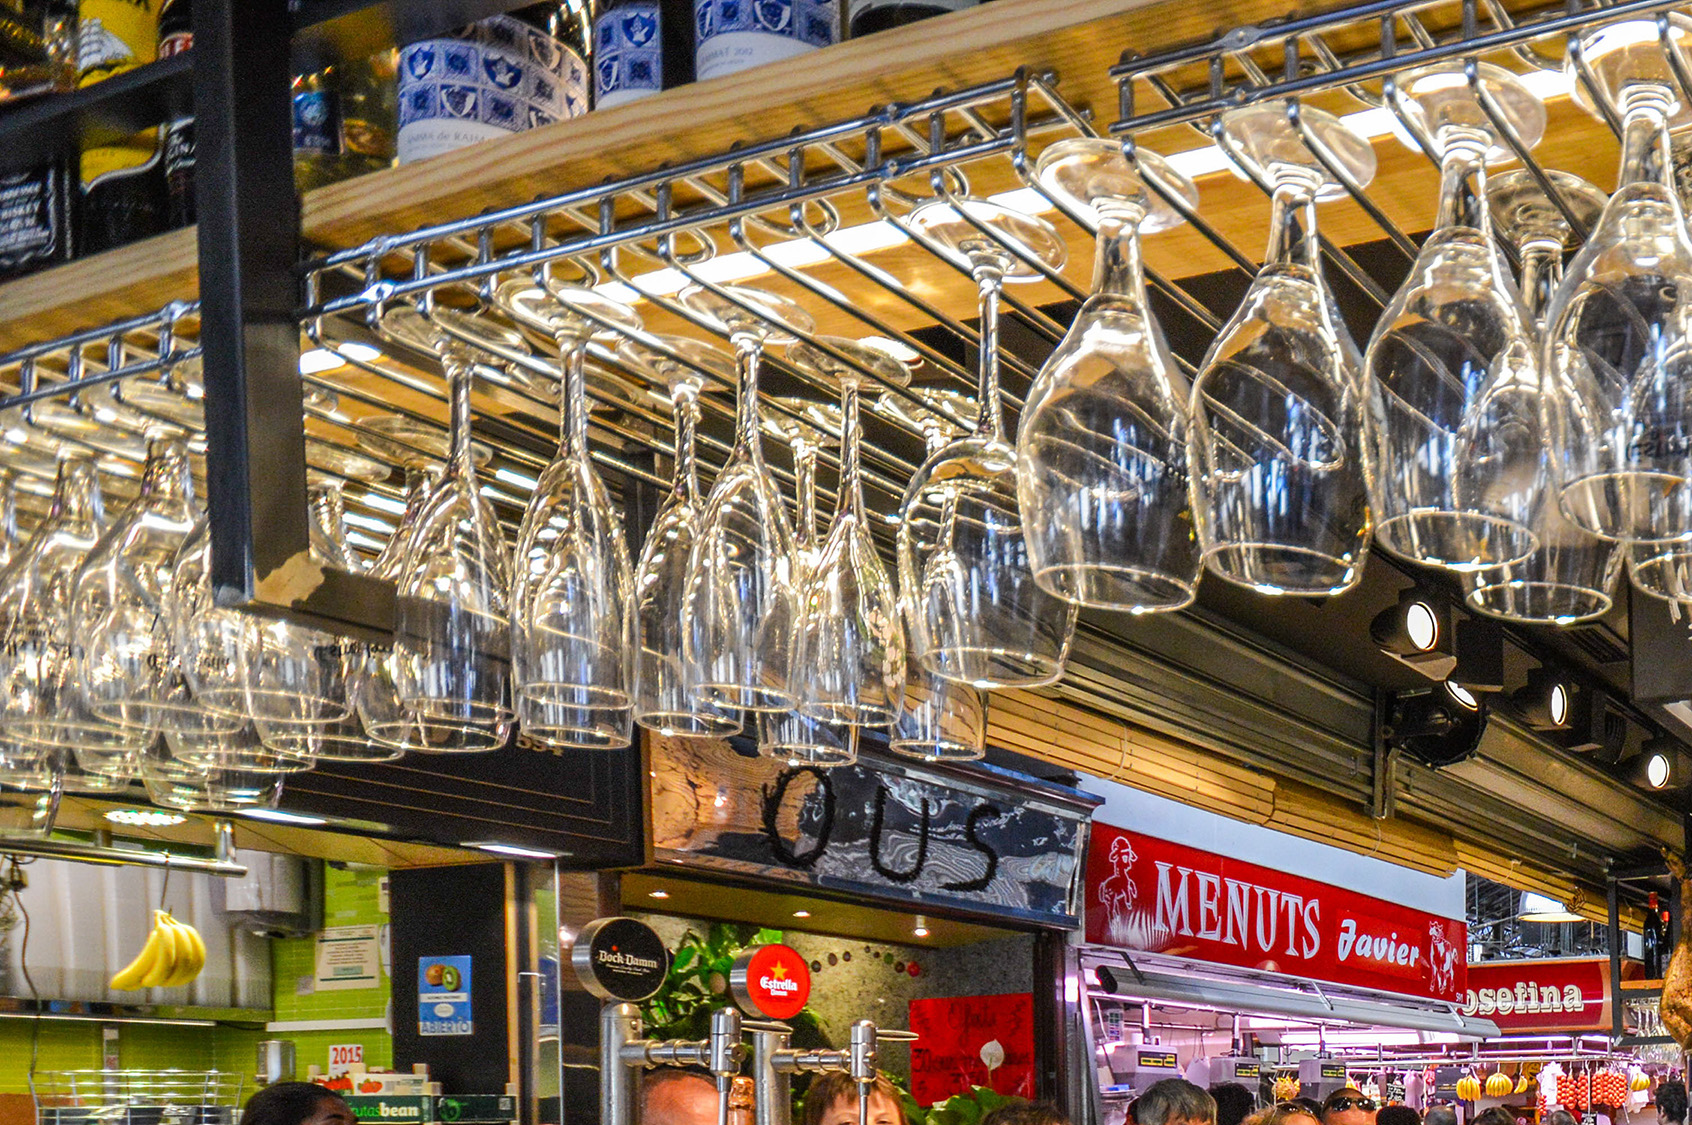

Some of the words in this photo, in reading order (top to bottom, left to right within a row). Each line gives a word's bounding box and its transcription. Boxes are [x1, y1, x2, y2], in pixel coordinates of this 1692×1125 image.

[1154, 860, 1322, 961] MENUTS
[1337, 918, 1421, 969] Javier
[598, 949, 625, 963] Bock
[625, 953, 658, 968] Damm
[759, 975, 799, 992] Estrella
[332, 1046, 363, 1065] 2015
